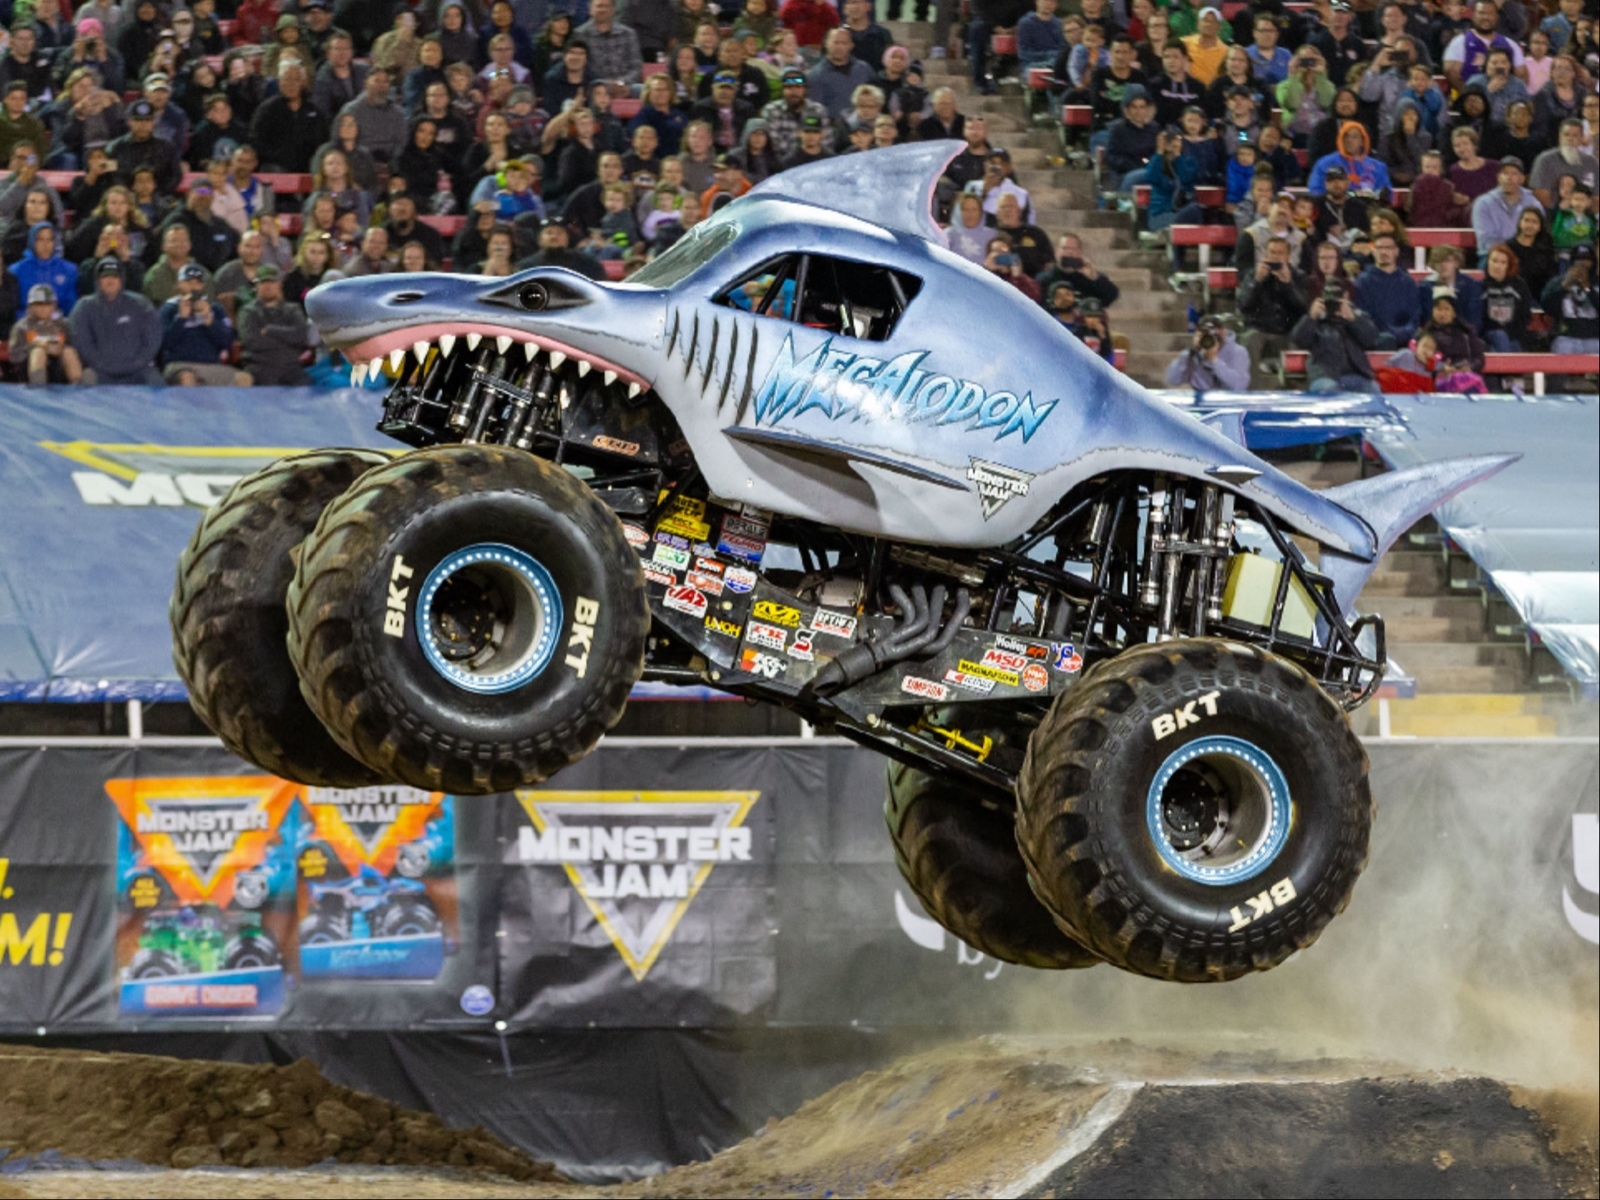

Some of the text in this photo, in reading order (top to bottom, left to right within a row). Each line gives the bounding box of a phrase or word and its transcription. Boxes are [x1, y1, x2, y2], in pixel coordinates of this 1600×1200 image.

[754, 328, 1060, 444] MEGALODON
[966, 467, 1030, 497] MONSTER
[979, 481, 1011, 502] JAM
[382, 555, 415, 639] BKT
[563, 597, 601, 679] BKT
[704, 615, 743, 639] UNOH
[995, 634, 1028, 655] Holley
[985, 650, 1026, 669] MSD
[961, 662, 1018, 685] MAGNAFLOW
[1151, 689, 1223, 742] BKT
[138, 810, 270, 834] MONSTER
[341, 804, 397, 823] JAM
[175, 833, 237, 853] JAM
[518, 826, 753, 862] MONSTER
[585, 864, 690, 899] JAM
[1228, 876, 1298, 934] BKT
